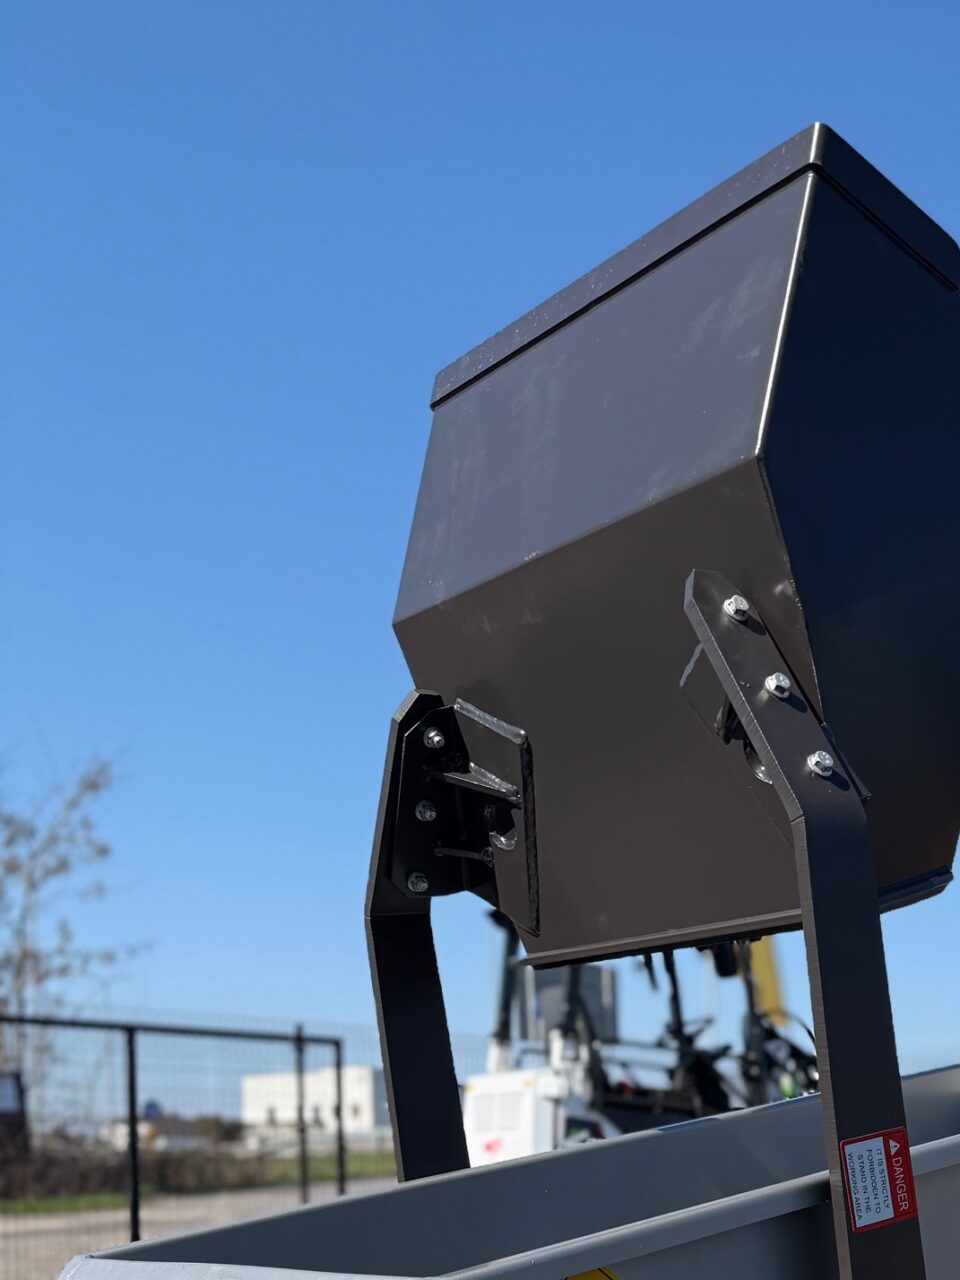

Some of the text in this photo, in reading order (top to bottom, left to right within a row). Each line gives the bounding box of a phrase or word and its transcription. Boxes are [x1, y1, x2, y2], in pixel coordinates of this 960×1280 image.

[848, 1153, 863, 1221] WORKING AREA
[858, 1154, 866, 1183] STAND
[864, 1197, 872, 1213] THE
[867, 1149, 882, 1214] FORBIDDEN TO
[879, 1169, 890, 1209] STRICTLY
[892, 1157, 908, 1211] DANGER
